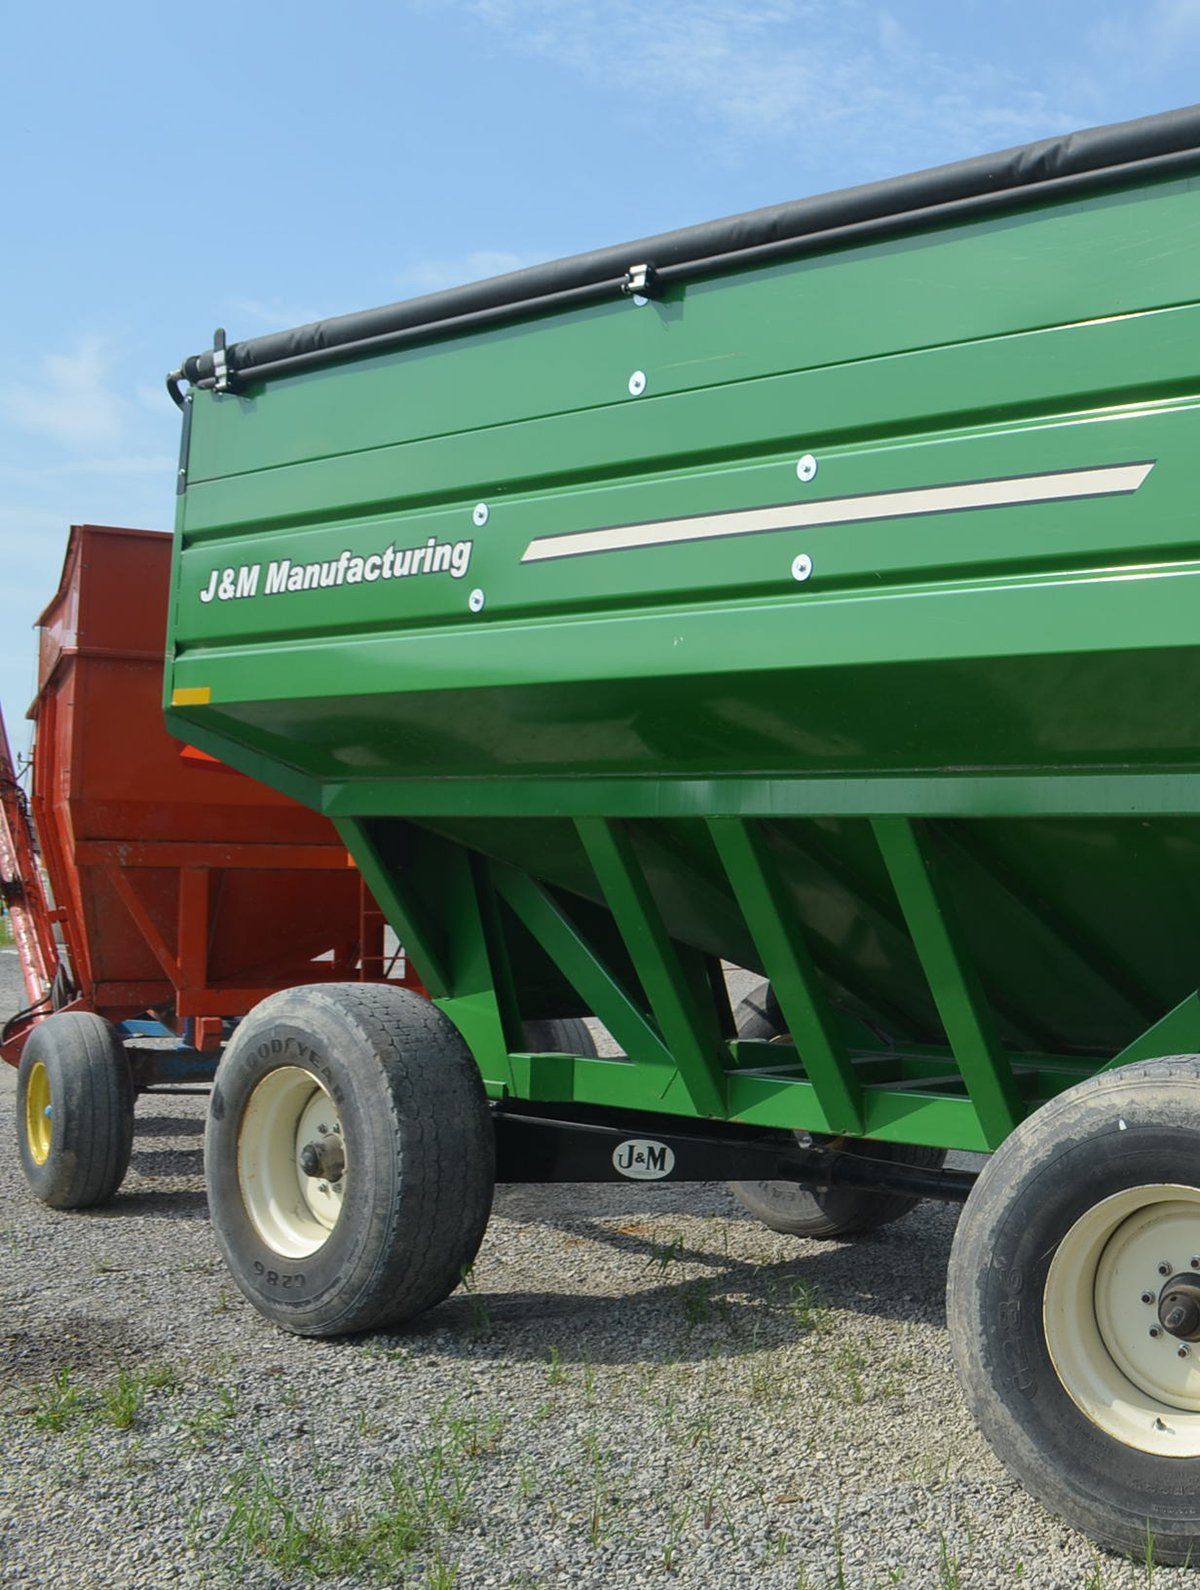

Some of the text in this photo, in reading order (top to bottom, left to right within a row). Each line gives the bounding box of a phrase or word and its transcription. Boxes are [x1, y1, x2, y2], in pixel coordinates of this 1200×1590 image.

[200, 537, 474, 603] J&M Manufacturing
[618, 1145, 667, 1172] J&M
